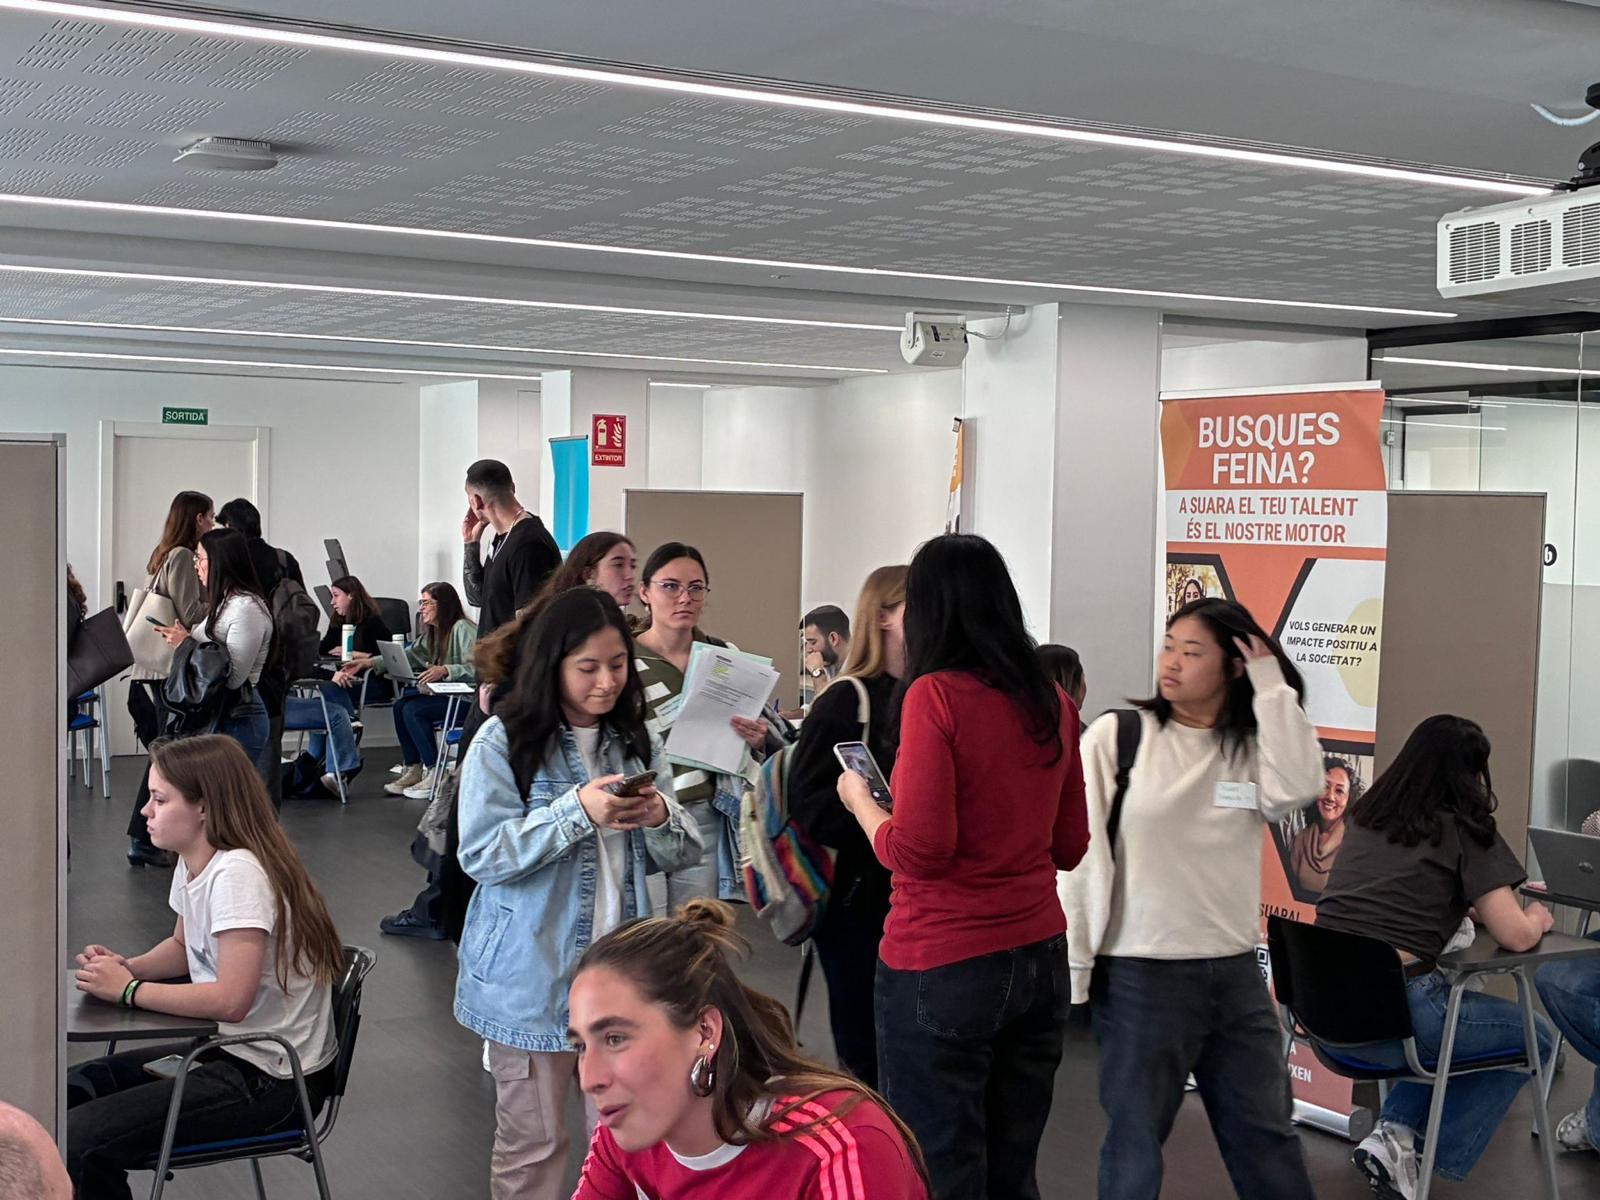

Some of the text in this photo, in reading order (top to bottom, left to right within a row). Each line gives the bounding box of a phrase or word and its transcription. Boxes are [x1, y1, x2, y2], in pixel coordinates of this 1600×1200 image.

[165, 410, 205, 421] SORTIDA
[1198, 412, 1340, 450] BUSQUES
[594, 454, 622, 462] EXTINTOR
[1212, 451, 1315, 484] FEINA?
[1178, 496, 1358, 516] A SUARA EL TEU TALENT
[1186, 517, 1345, 543] ÉS EL NOSTRE MOTOR
[1289, 621, 1376, 635] VOLS GENERAR UN
[1286, 636, 1377, 651] IMPACTE POSITIU A
[1296, 652, 1362, 666] LA SOCIETAT?
